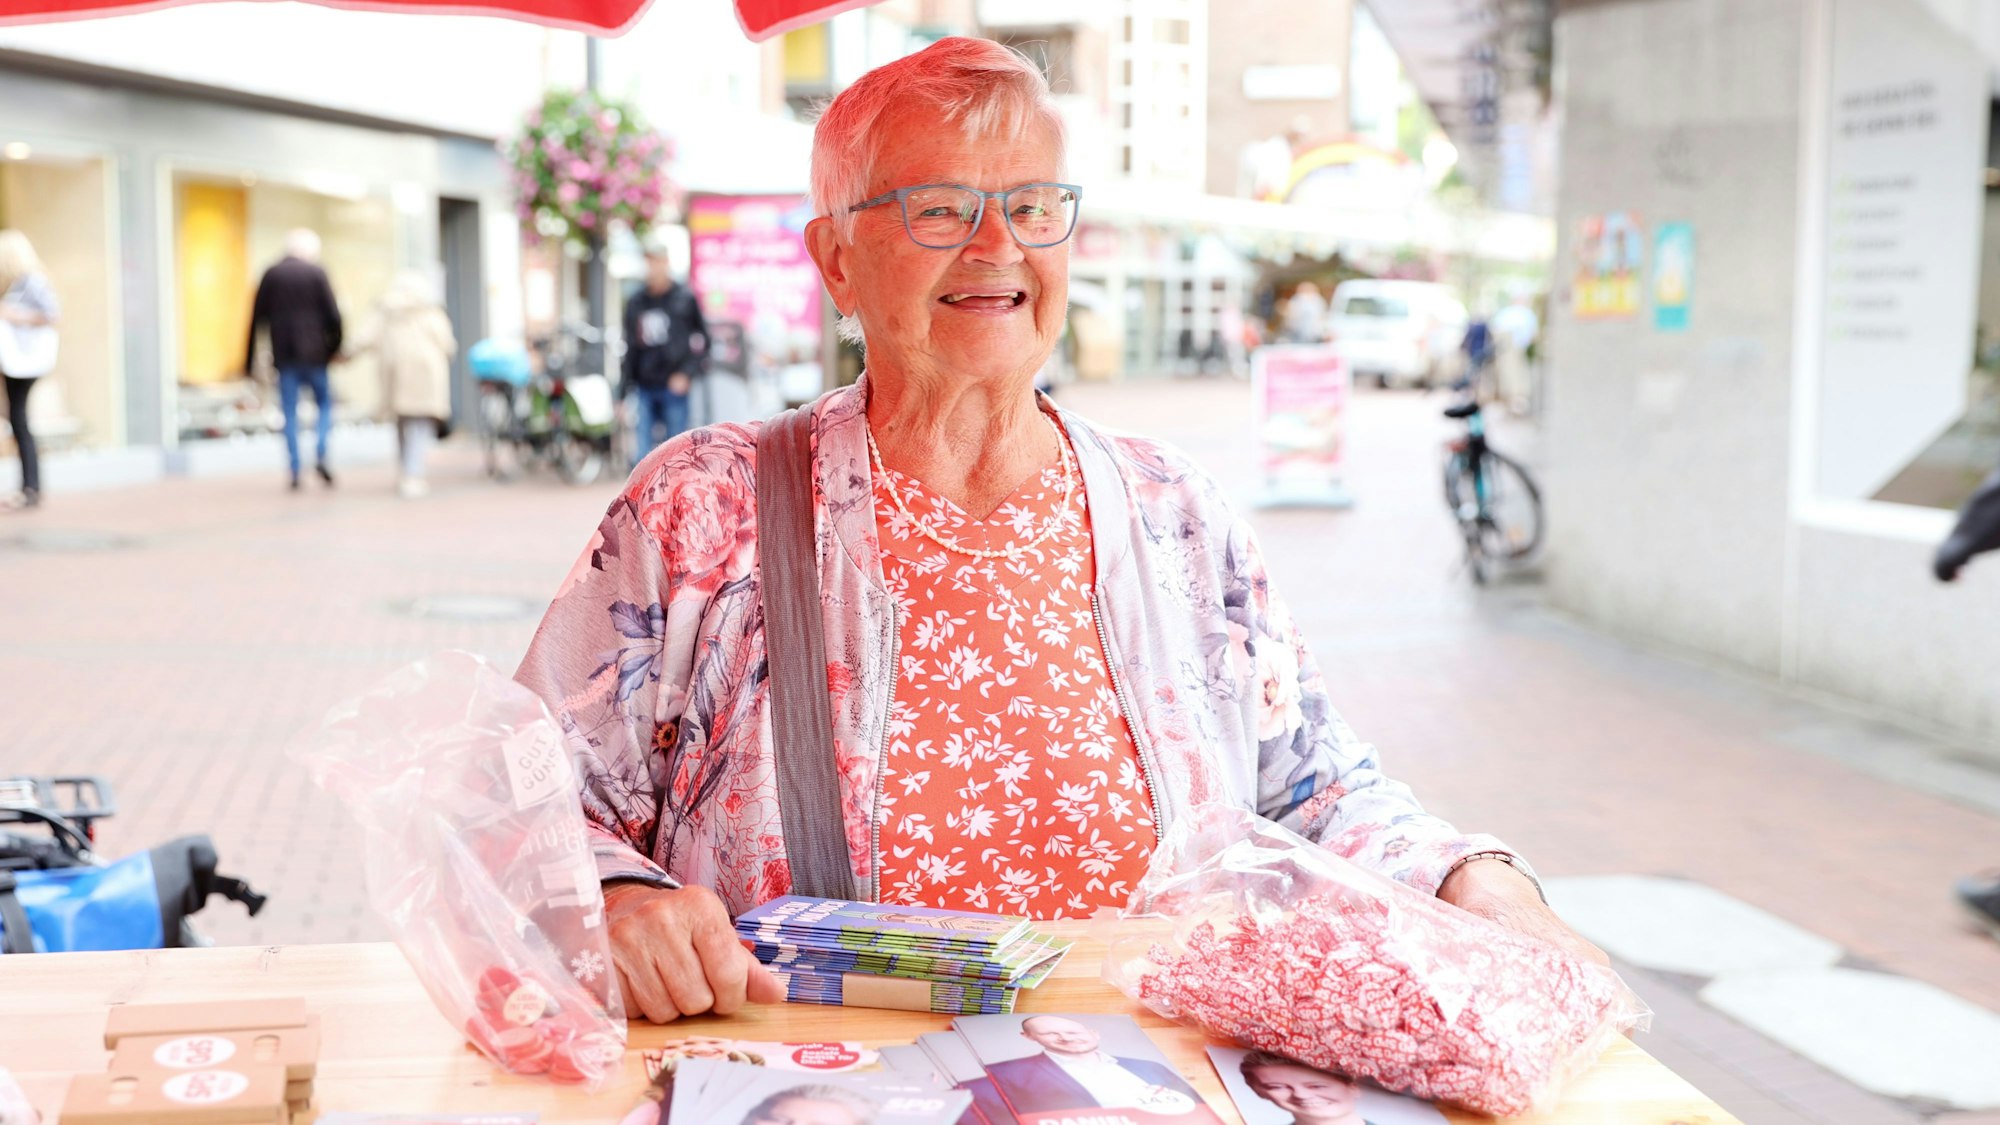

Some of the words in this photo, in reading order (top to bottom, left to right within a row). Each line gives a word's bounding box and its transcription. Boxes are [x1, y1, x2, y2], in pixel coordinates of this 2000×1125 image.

[518, 737, 547, 770] GUT
[1221, 1018, 1241, 1033] SPD
[1257, 1034, 1277, 1046] SPD
[1291, 1035, 1310, 1048] SPD
